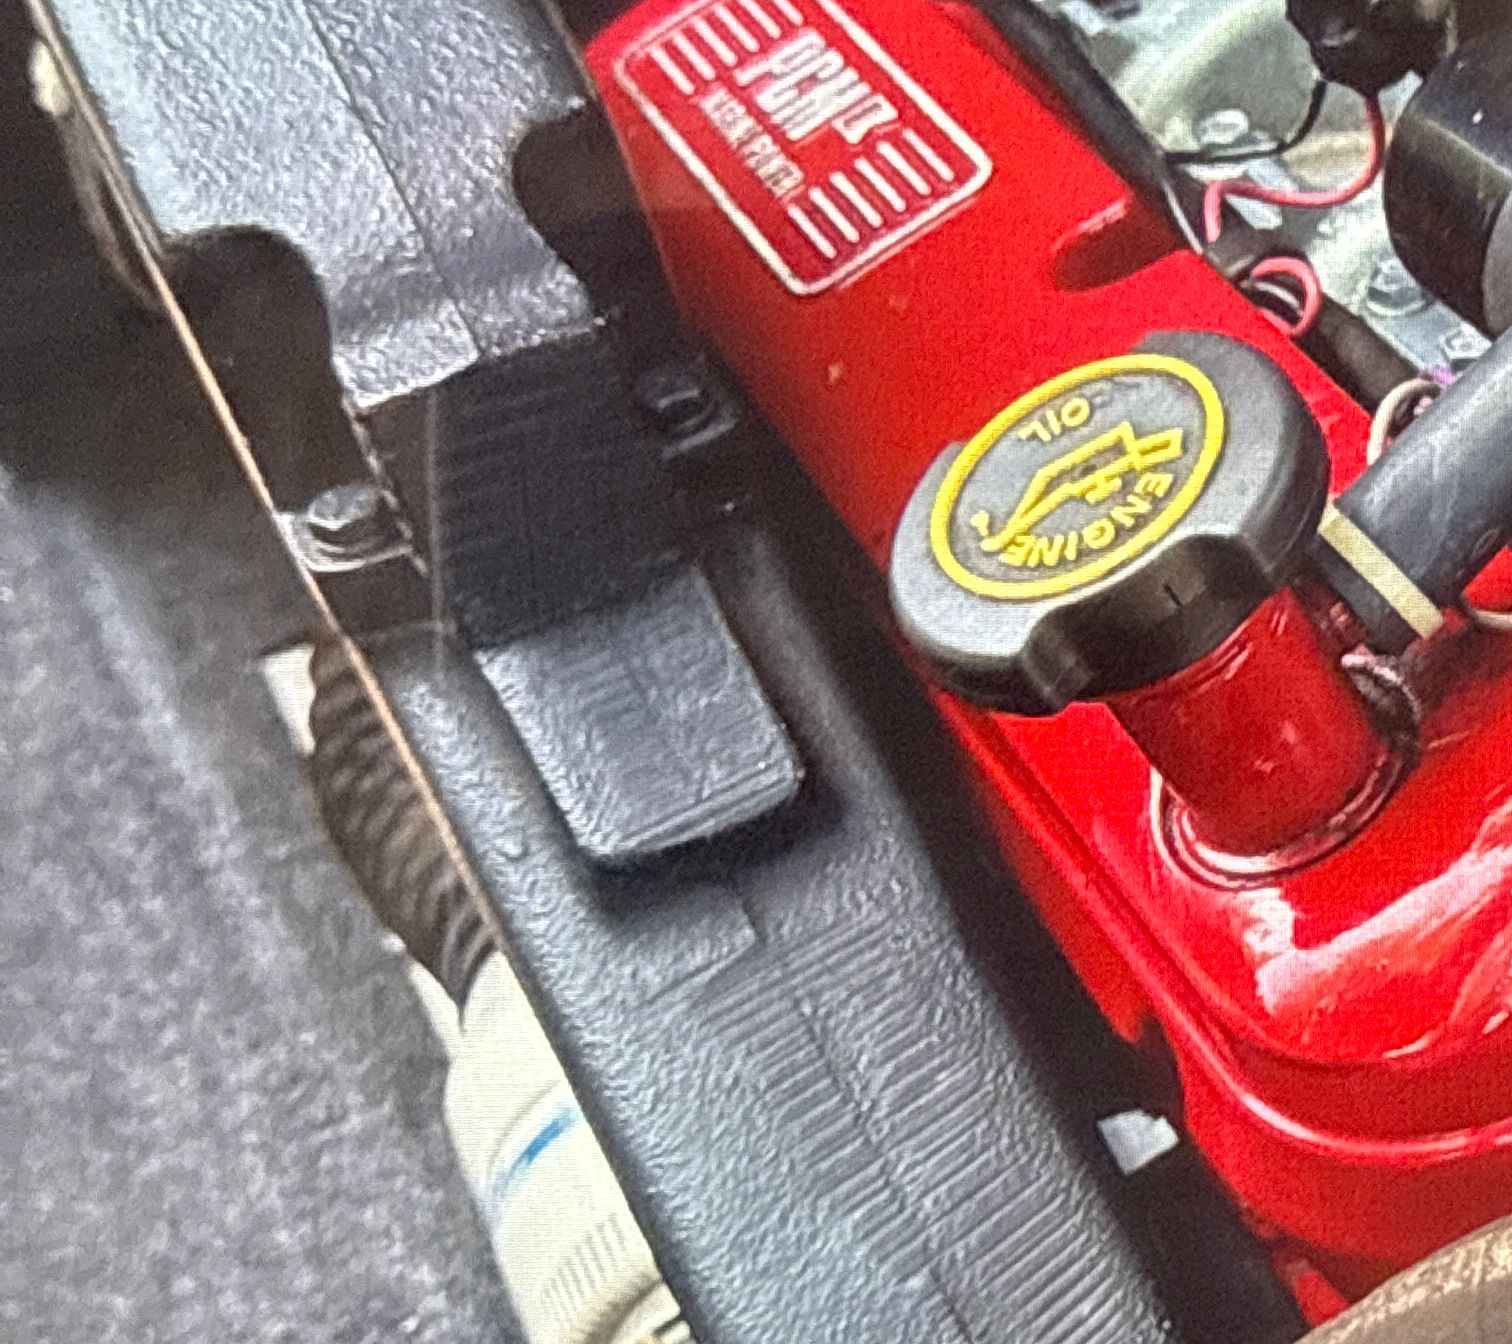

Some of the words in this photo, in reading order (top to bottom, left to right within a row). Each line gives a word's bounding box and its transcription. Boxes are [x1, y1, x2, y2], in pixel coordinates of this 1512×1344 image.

[733, 26, 872, 142] PCM
[1017, 397, 1091, 441] OIL
[999, 473, 1173, 567] ENGINE
